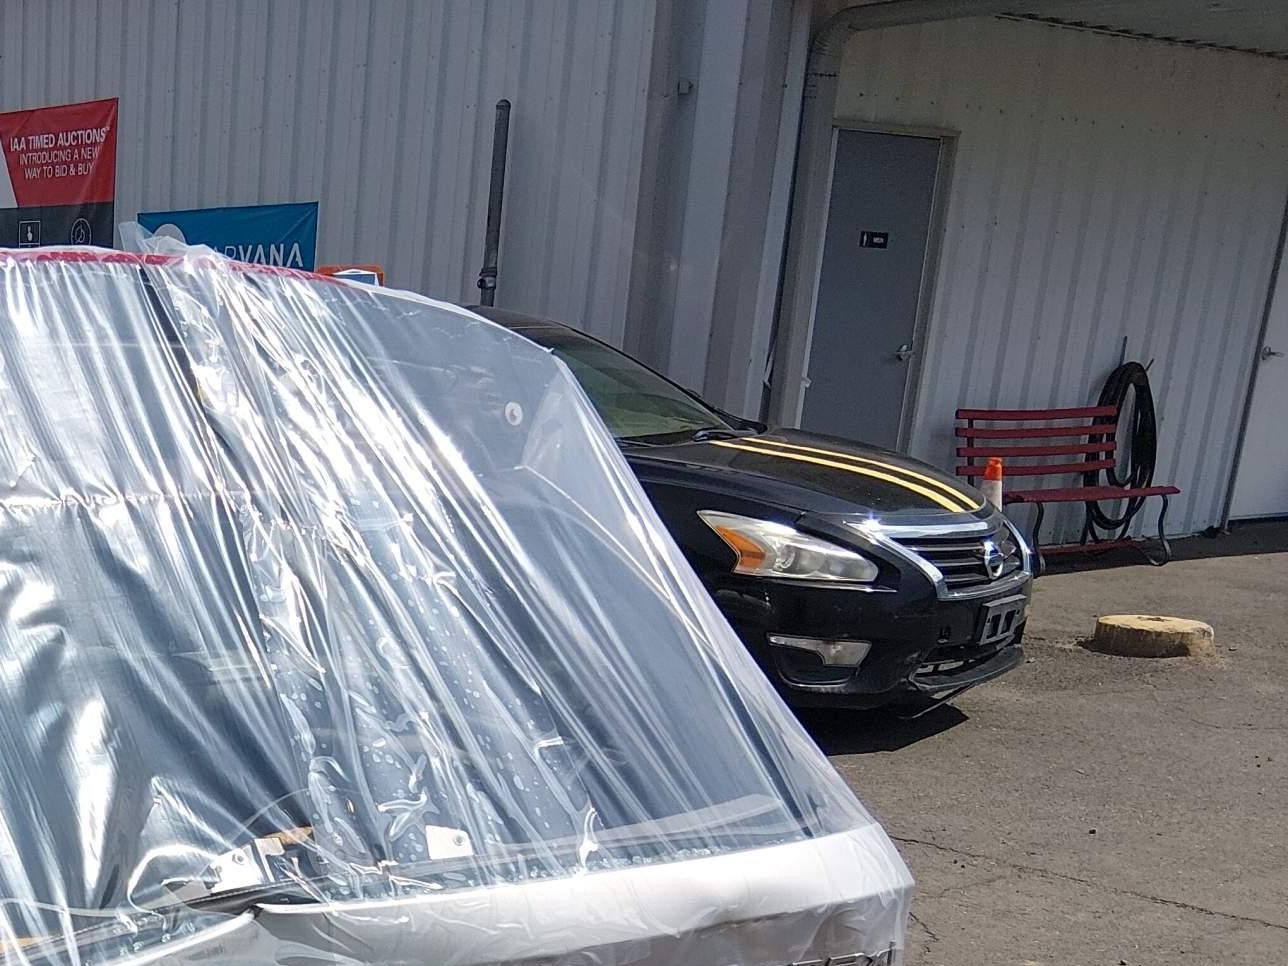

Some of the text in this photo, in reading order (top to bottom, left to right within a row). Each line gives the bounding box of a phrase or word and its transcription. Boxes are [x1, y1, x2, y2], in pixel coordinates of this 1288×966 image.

[10, 136, 27, 152] IAA
[28, 134, 56, 150] TIMED
[19, 145, 101, 166] INTRODUCING A NEW
[24, 161, 96, 180] WAY TO BID & BUY
